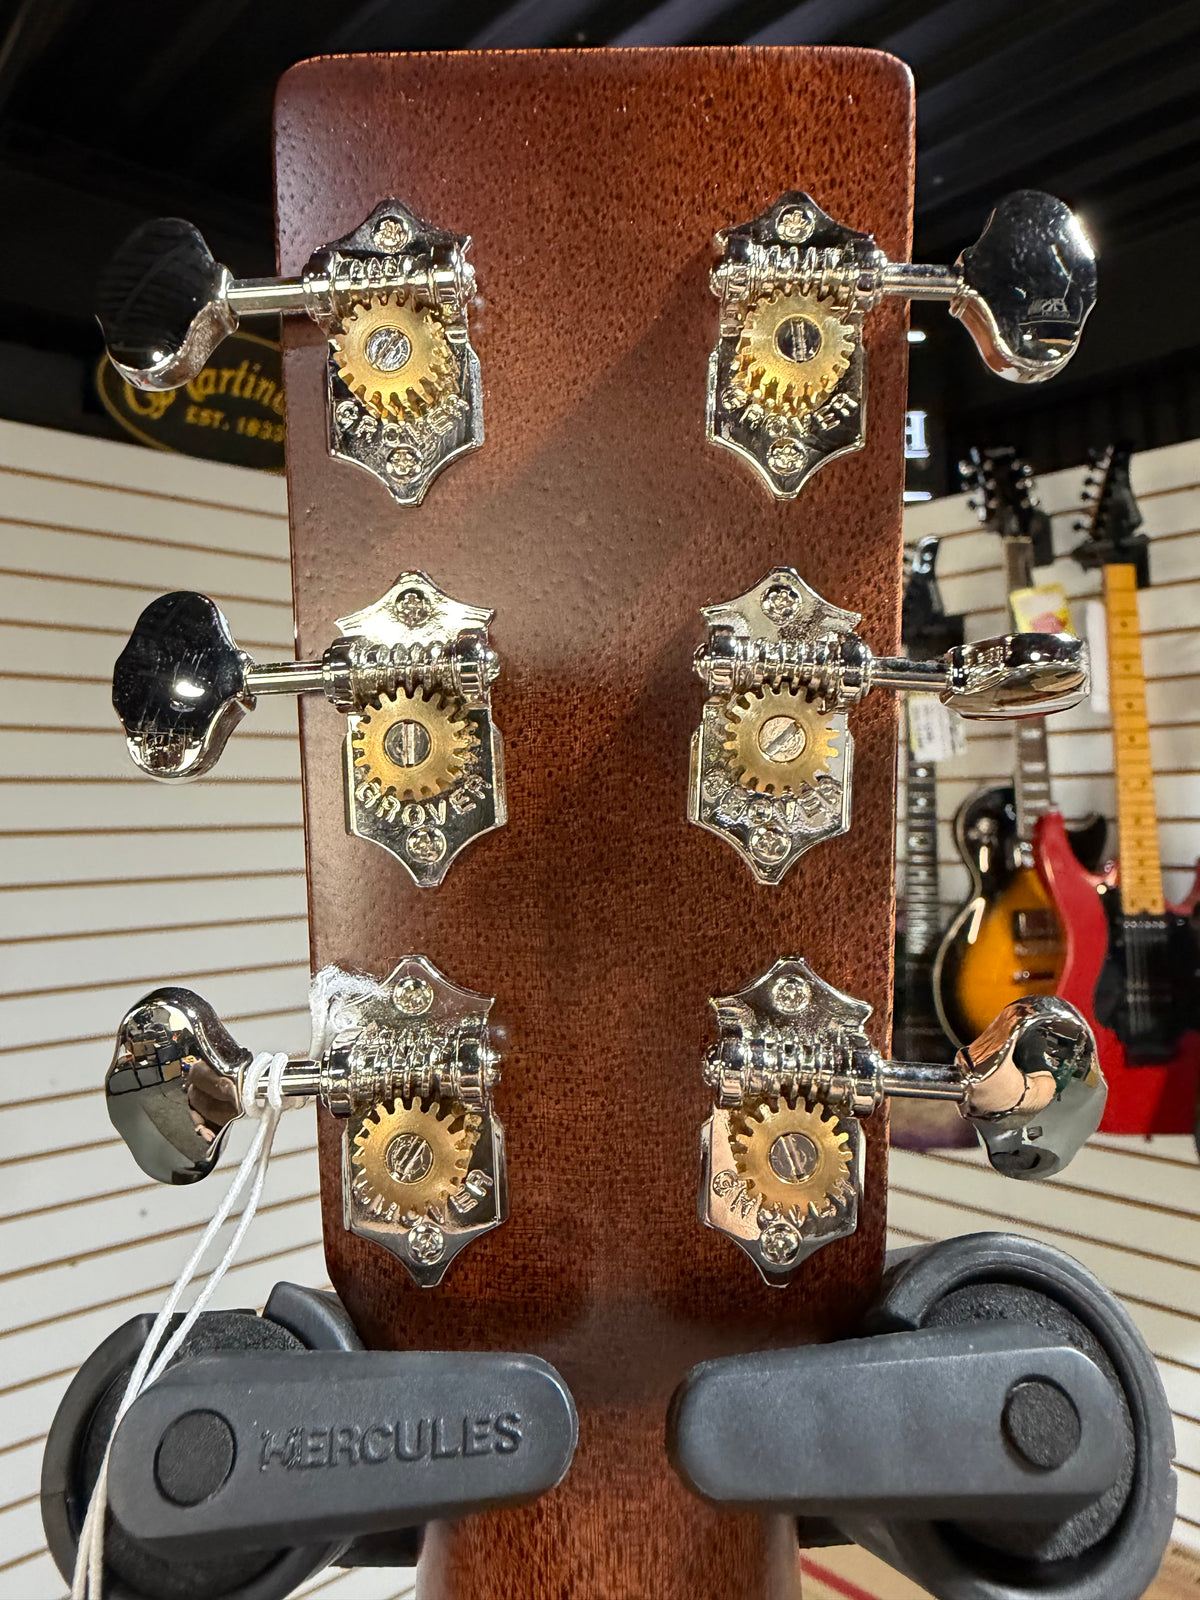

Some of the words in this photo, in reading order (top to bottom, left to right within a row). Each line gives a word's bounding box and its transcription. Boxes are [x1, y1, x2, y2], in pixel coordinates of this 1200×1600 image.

[185, 405, 231, 431] EST.
[355, 774, 493, 827] GROVER
[259, 1412, 523, 1470] HERCULES
